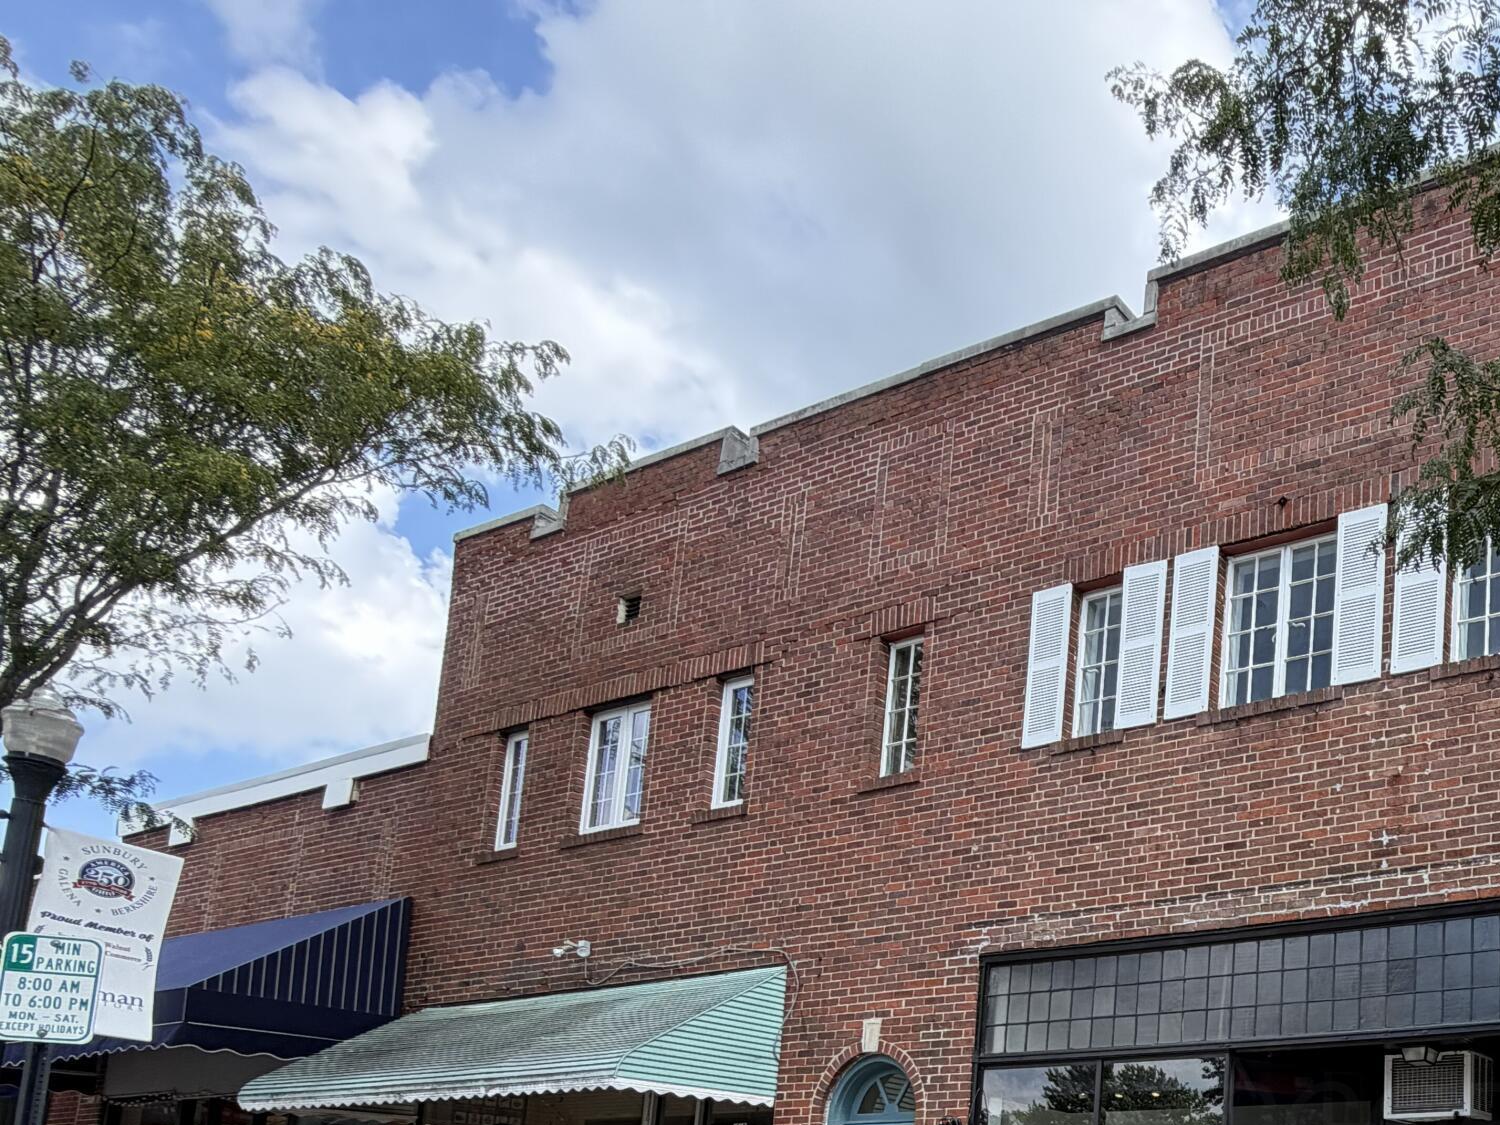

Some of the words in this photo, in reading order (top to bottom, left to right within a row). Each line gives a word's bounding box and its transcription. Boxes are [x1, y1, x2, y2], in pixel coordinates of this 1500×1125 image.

[81, 845, 149, 870] SUNBURY
[83, 867, 130, 887] 250
[57, 867, 83, 908] GALENA
[111, 884, 159, 917] BERKSHIRE
[39, 910, 84, 926] Proud
[83, 920, 137, 938] Member
[138, 932, 155, 943] of
[11, 943, 35, 964] 15
[54, 941, 82, 956] MIN
[35, 956, 96, 974] PARKING
[17, 976, 53, 992] 8:00
[57, 979, 81, 994] AM
[4, 992, 22, 1007] TO
[28, 995, 62, 1010] 6:00
[68, 997, 90, 1012] PM
[8, 1010, 38, 1021] MON.
[54, 1013, 79, 1024] SAT.
[0, 1021, 35, 1031] EXCEPT
[38, 1023, 85, 1035] HOLIDAYS
